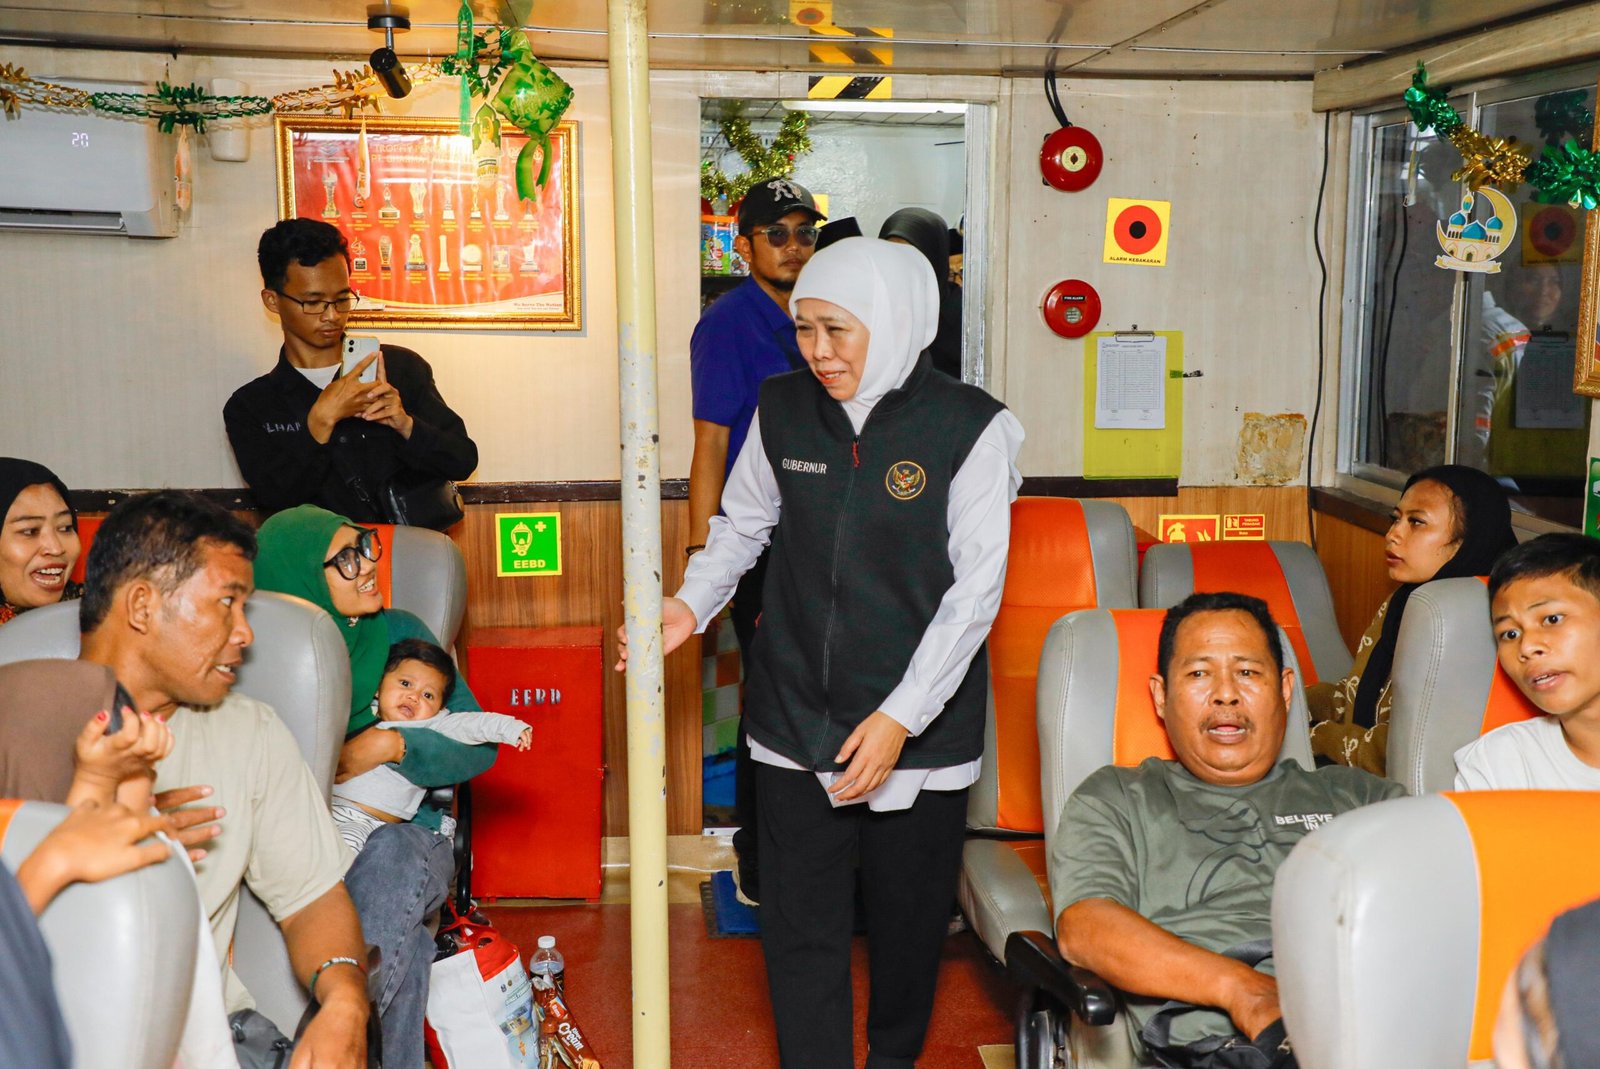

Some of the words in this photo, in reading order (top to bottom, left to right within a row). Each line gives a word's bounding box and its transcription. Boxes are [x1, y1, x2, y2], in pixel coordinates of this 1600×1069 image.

[71, 131, 89, 147] 20
[782, 457, 827, 474] GUBERNUR
[513, 559, 546, 569] EEBD
[1304, 821, 1319, 831] IN
[558, 1022, 584, 1051] Cream
